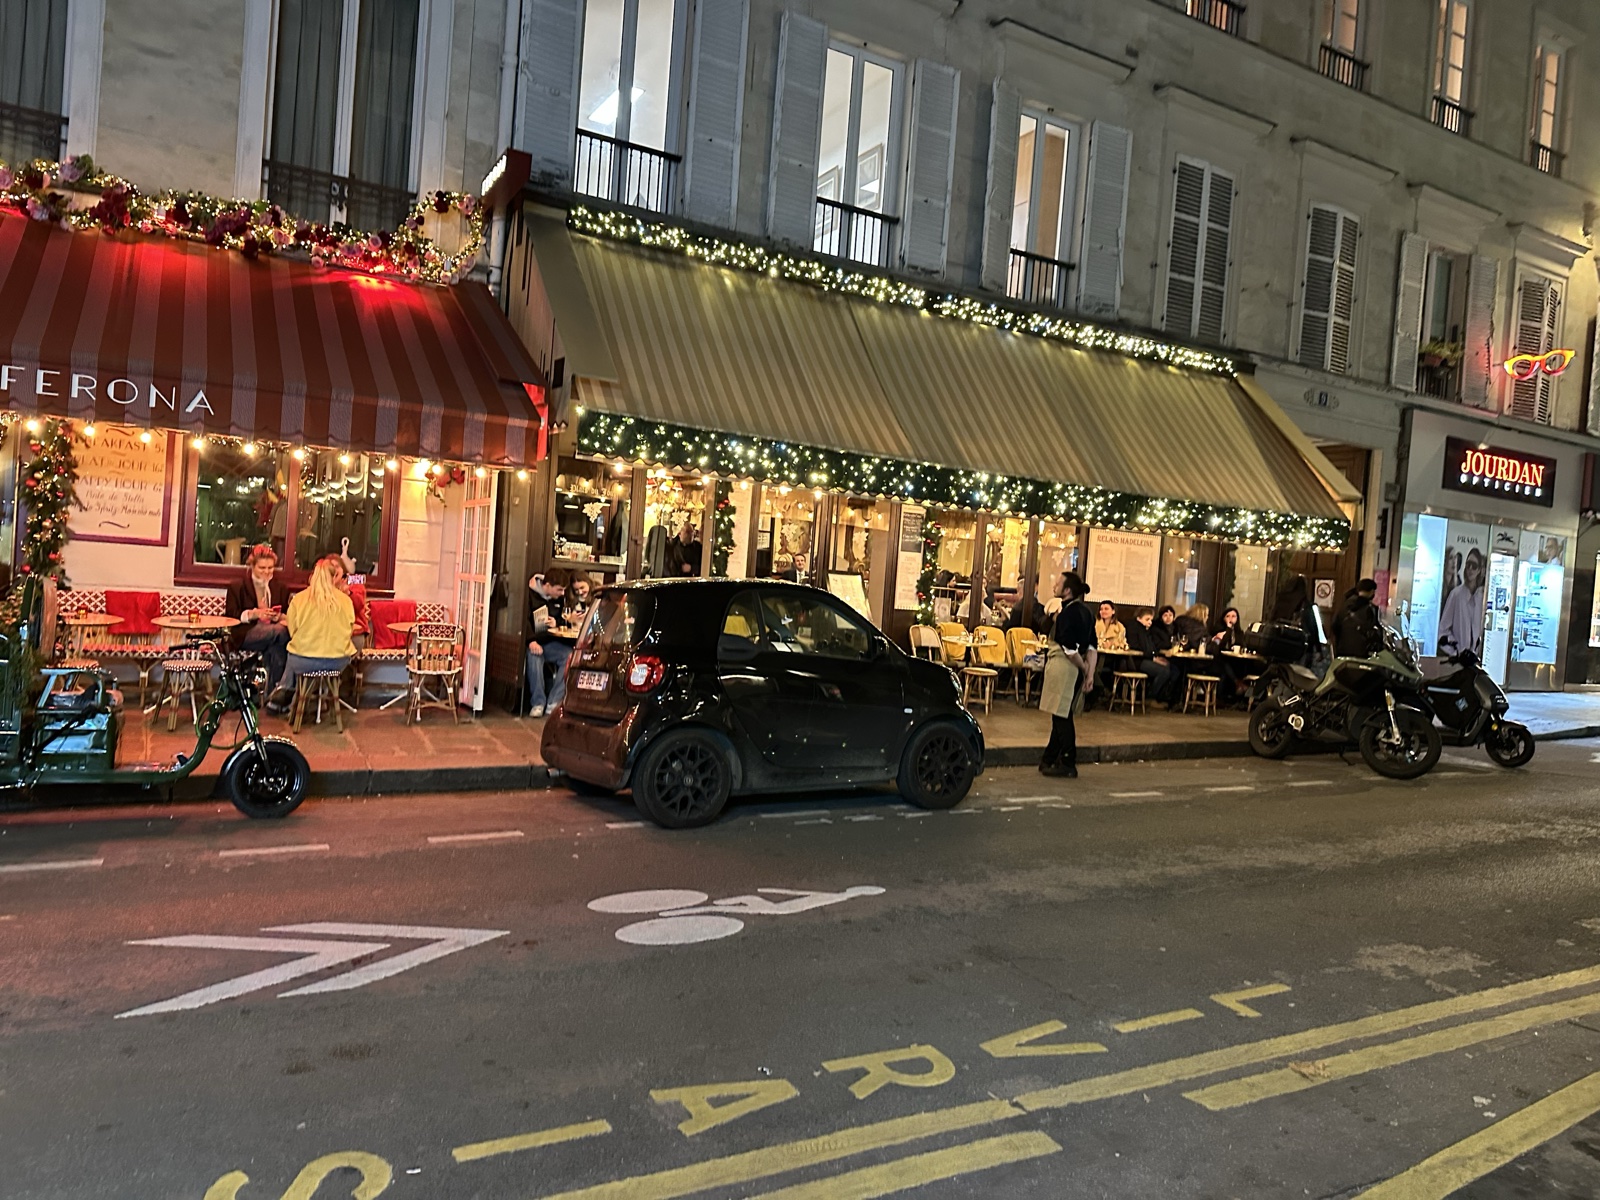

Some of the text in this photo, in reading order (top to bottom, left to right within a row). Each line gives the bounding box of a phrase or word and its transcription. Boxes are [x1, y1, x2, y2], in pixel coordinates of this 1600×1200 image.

[1, 365, 215, 416] FERONA
[117, 458, 148, 472] JOUR
[1460, 449, 1545, 487] JOURDAN
[114, 478, 148, 491] HOUR
[1459, 473, 1543, 498] OPTICIEN
[123, 492, 145, 503] Stella
[1097, 534, 1153, 547] RELAIS MADELEINE
[1456, 534, 1479, 546] PRADA
